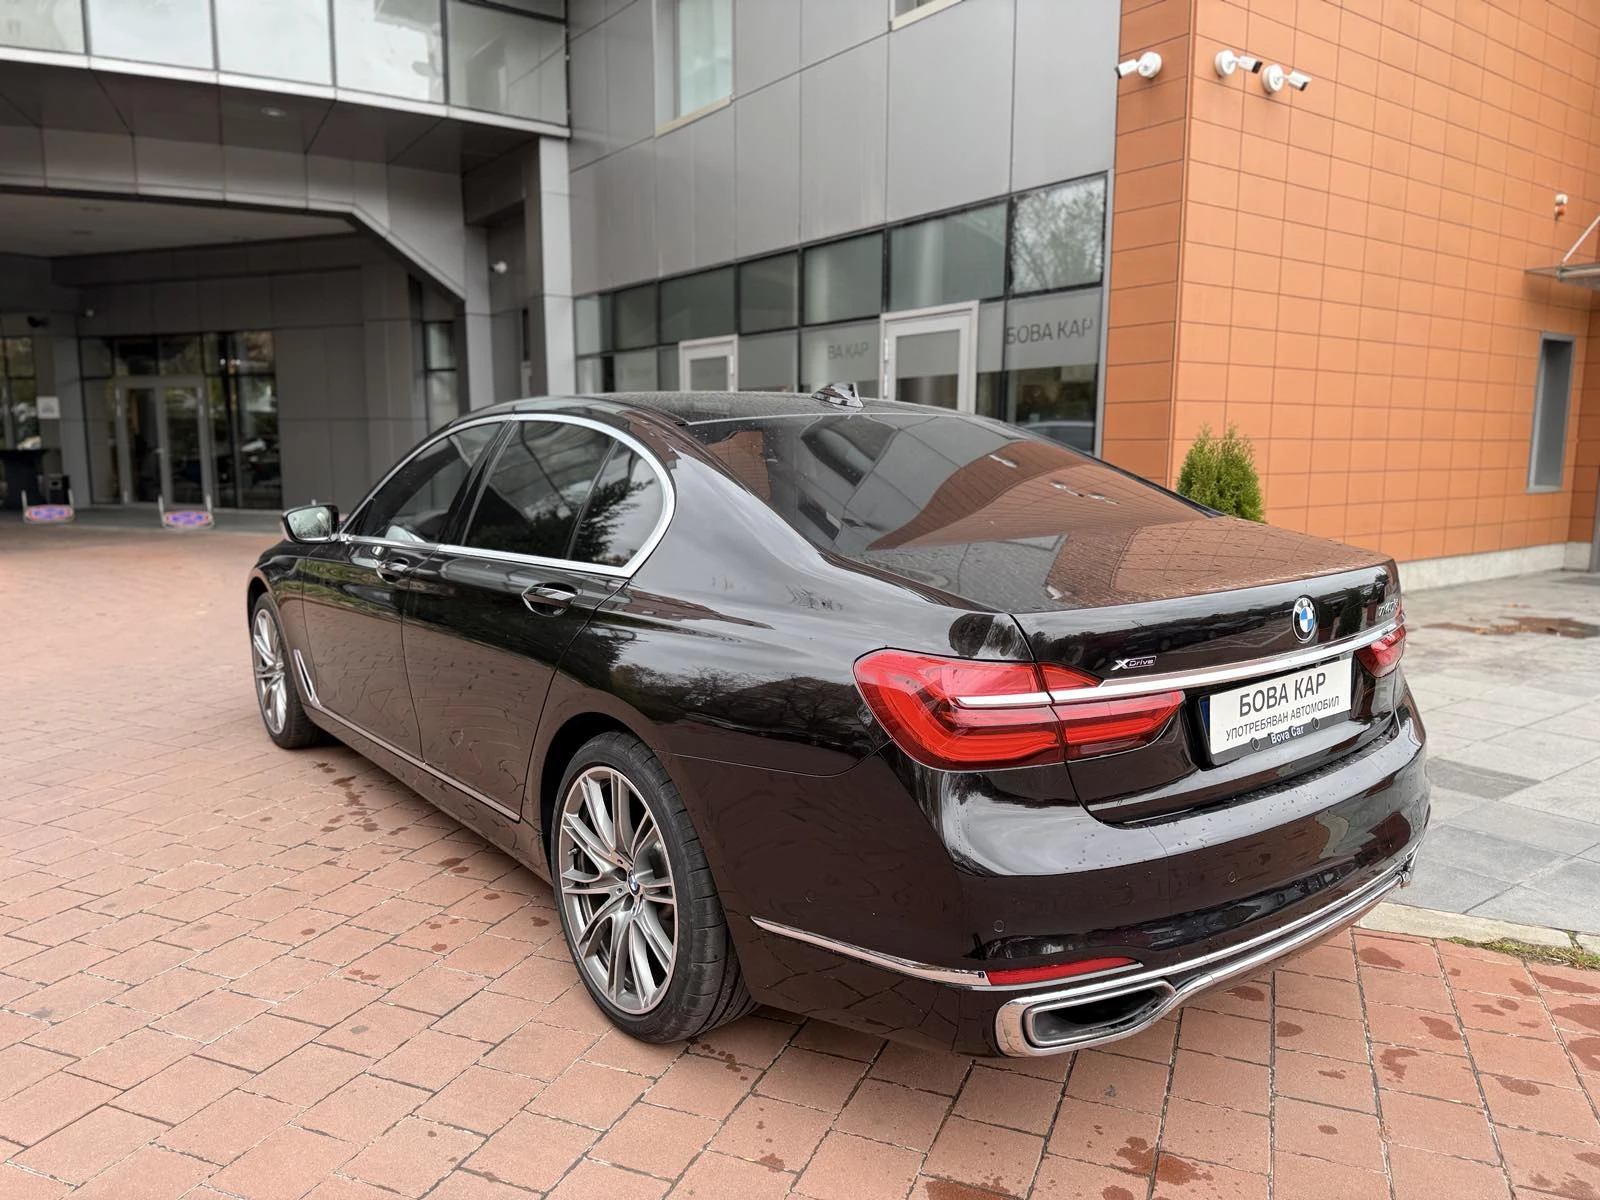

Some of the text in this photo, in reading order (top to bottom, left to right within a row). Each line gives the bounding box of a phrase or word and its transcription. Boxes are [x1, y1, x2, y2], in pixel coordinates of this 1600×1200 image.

[1006, 318, 1093, 345] БОВА КАР
[1239, 672, 1326, 718] БОВА КАР
[1225, 696, 1340, 742] УПОТРЕБЯВАН АВТОМОБИЛ
[1270, 726, 1304, 744] Bova Car
